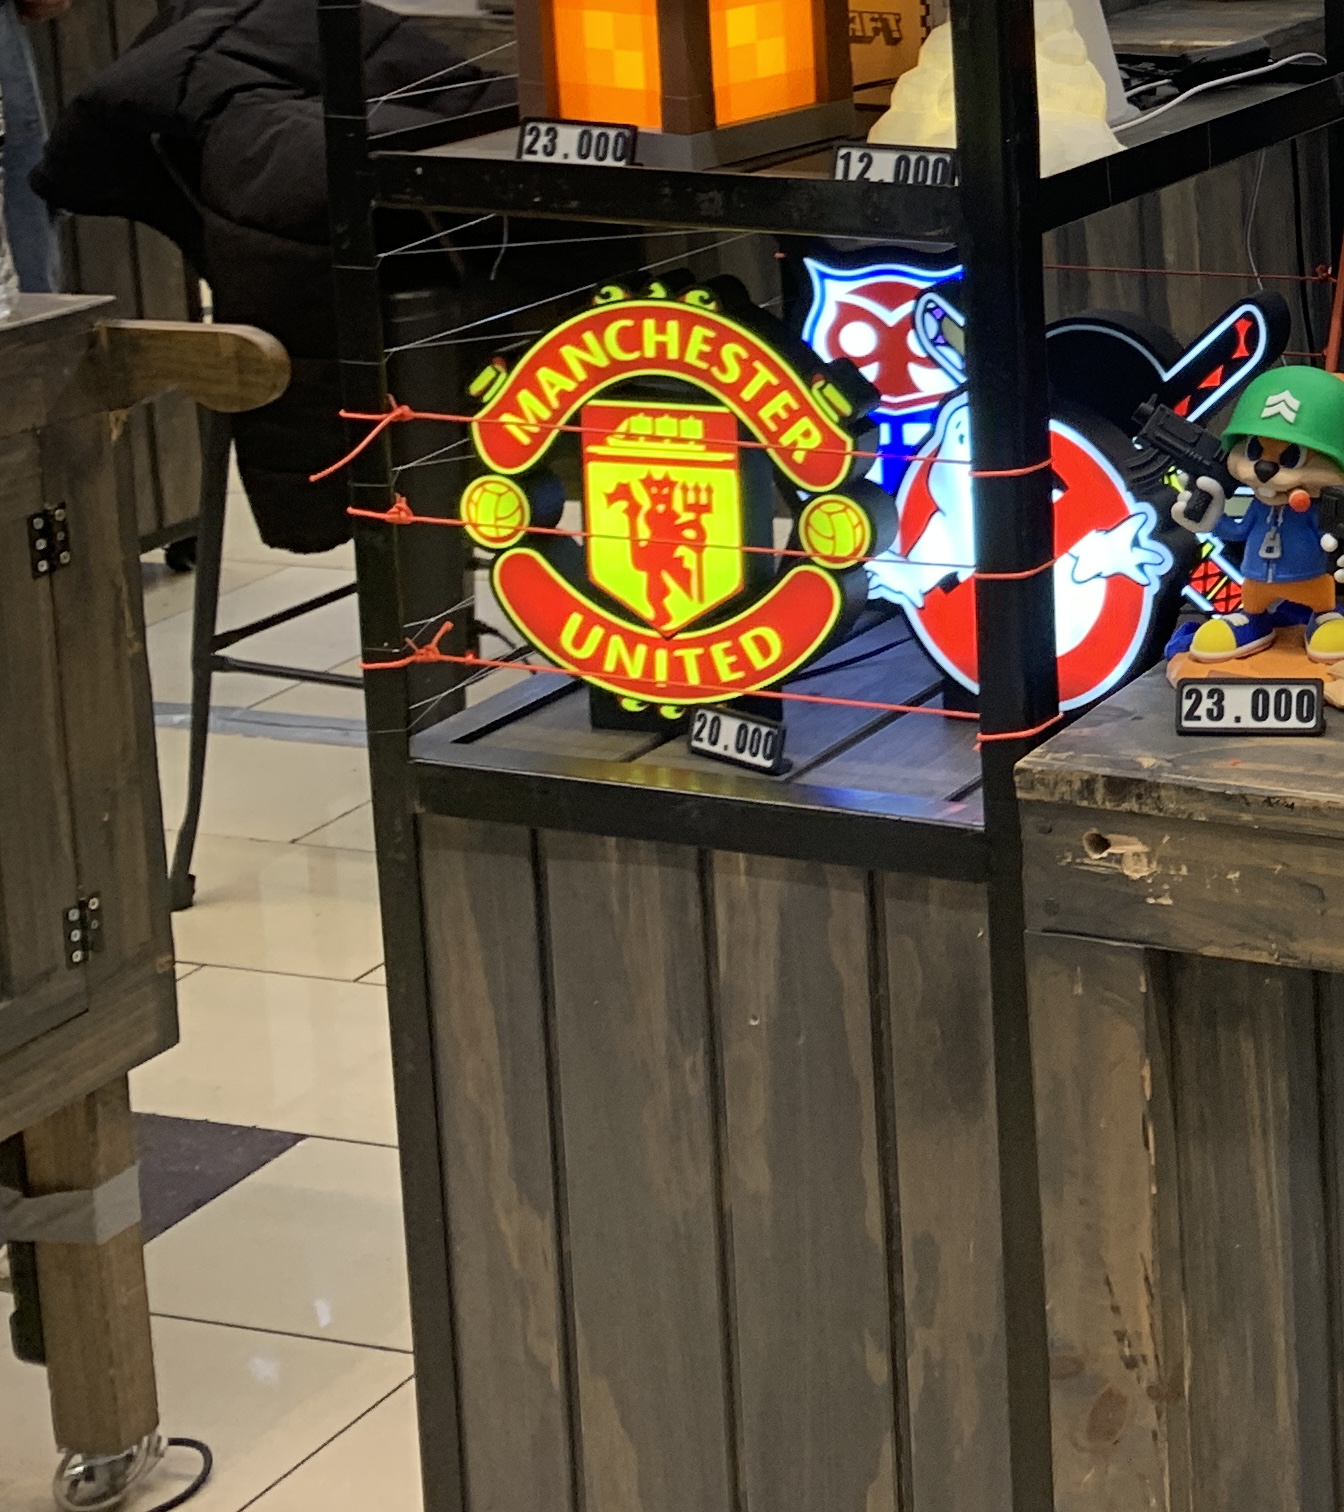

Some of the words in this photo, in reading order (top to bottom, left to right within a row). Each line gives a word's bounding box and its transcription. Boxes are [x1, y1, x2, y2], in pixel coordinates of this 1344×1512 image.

[523, 125, 628, 162] 23.000
[838, 151, 953, 184] 12.000
[502, 319, 824, 464] MANCHESTER
[559, 613, 784, 686] UNITED
[1184, 688, 1315, 723] 23.000
[693, 711, 777, 762] 20.000
